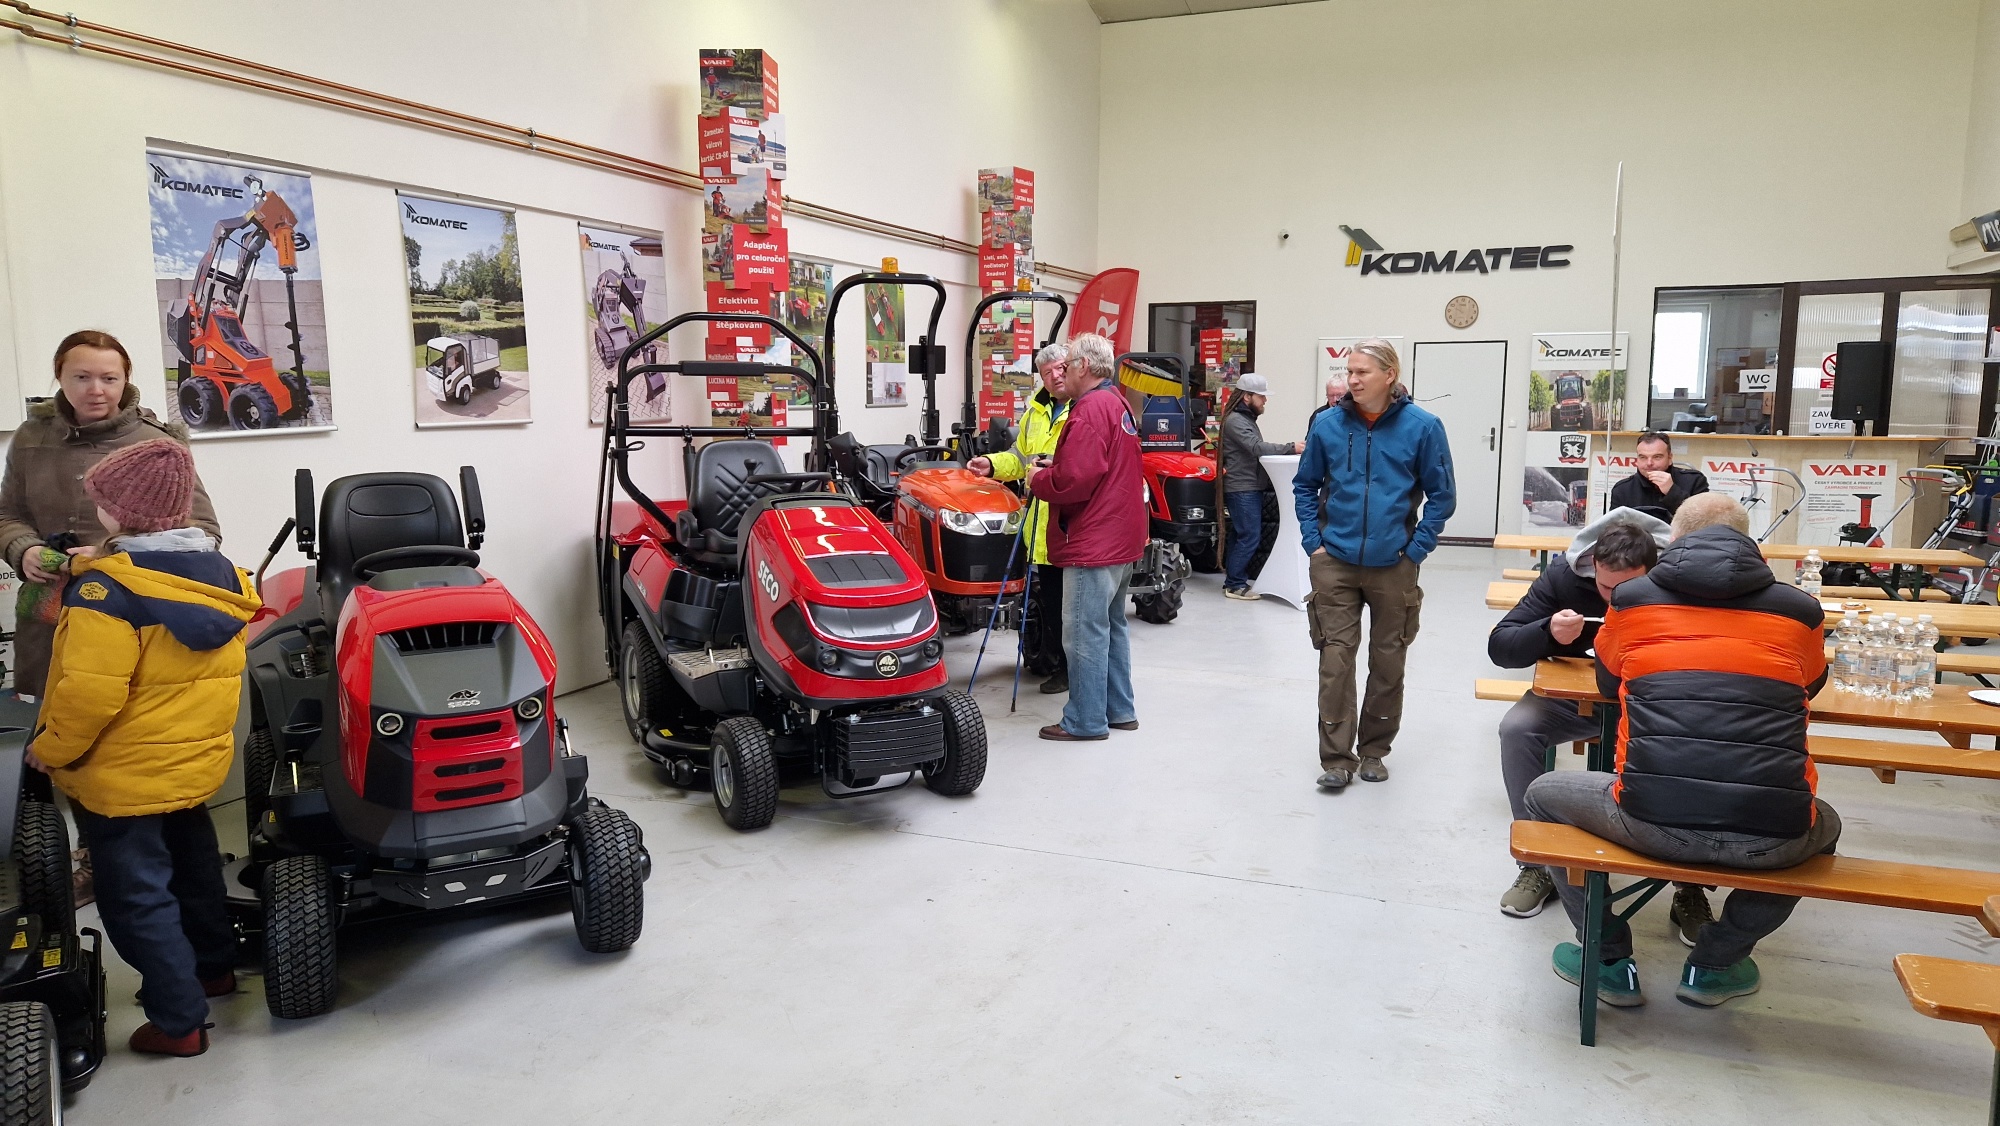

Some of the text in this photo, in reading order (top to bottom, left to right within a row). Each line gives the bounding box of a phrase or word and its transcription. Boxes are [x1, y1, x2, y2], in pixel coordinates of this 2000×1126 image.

[732, 118, 753, 126] VARI
[161, 179, 244, 199] KOMATEC
[411, 215, 468, 230] KOMATEC
[588, 241, 621, 251] KOMATEC
[743, 241, 778, 251] Adaptéry
[751, 254, 786, 263] celoroční
[1360, 244, 1574, 275] KOMATEC
[748, 266, 775, 275] použití
[716, 321, 762, 330] štěpkování
[1545, 348, 1622, 357] KOMATEC
[1746, 374, 1770, 384] WC
[1815, 421, 1846, 429] DVEŘE
[1597, 455, 1638, 467] VAR
[1707, 461, 1766, 474] VARI
[1809, 464, 1887, 476] VARI
[758, 560, 779, 602] SECO
[447, 699, 481, 709] SECO
